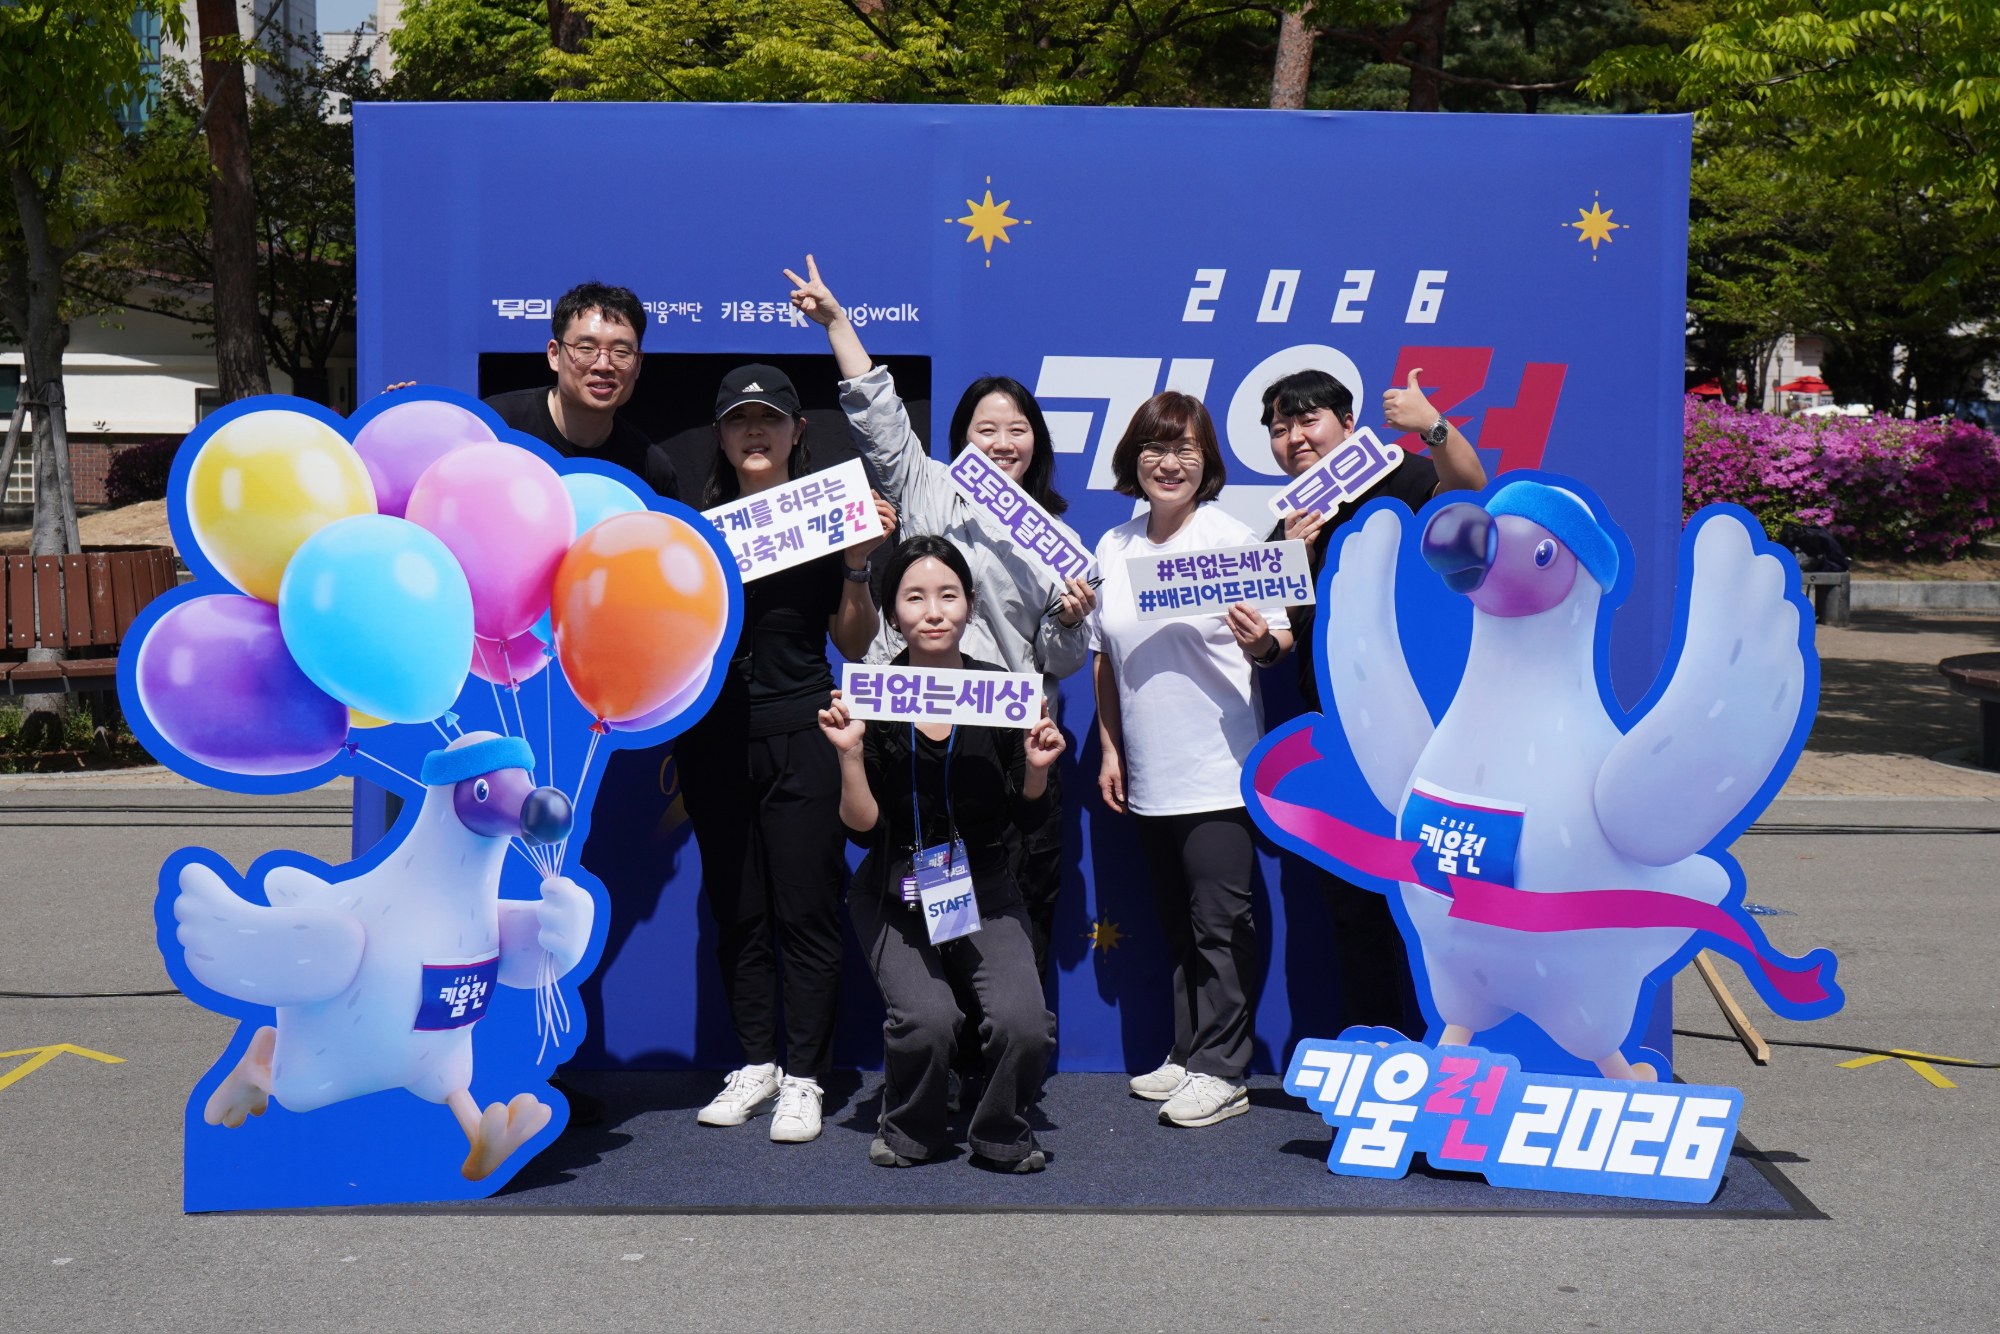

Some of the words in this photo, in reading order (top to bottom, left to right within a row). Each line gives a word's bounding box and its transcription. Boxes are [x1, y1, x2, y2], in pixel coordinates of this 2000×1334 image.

[642, 301, 703, 324] 키움재단
[1182, 269, 1448, 324] 2026
[776, 477, 847, 514] 허무는
[807, 500, 868, 546] 키움런
[953, 455, 1024, 523] 모두의
[1013, 508, 1085, 579] 달리기
[1156, 547, 1284, 582] #턱없는세상
[1138, 574, 1308, 612] #배리어프리러닝
[850, 672, 1035, 722] 턱없는세상
[1440, 816, 1475, 832] 2026
[1419, 823, 1487, 875] 키움런
[928, 893, 972, 918] STAFF
[439, 982, 488, 1018] 키움런
[1295, 1049, 1508, 1168] 키움런
[1497, 1084, 1732, 1180] 2026
